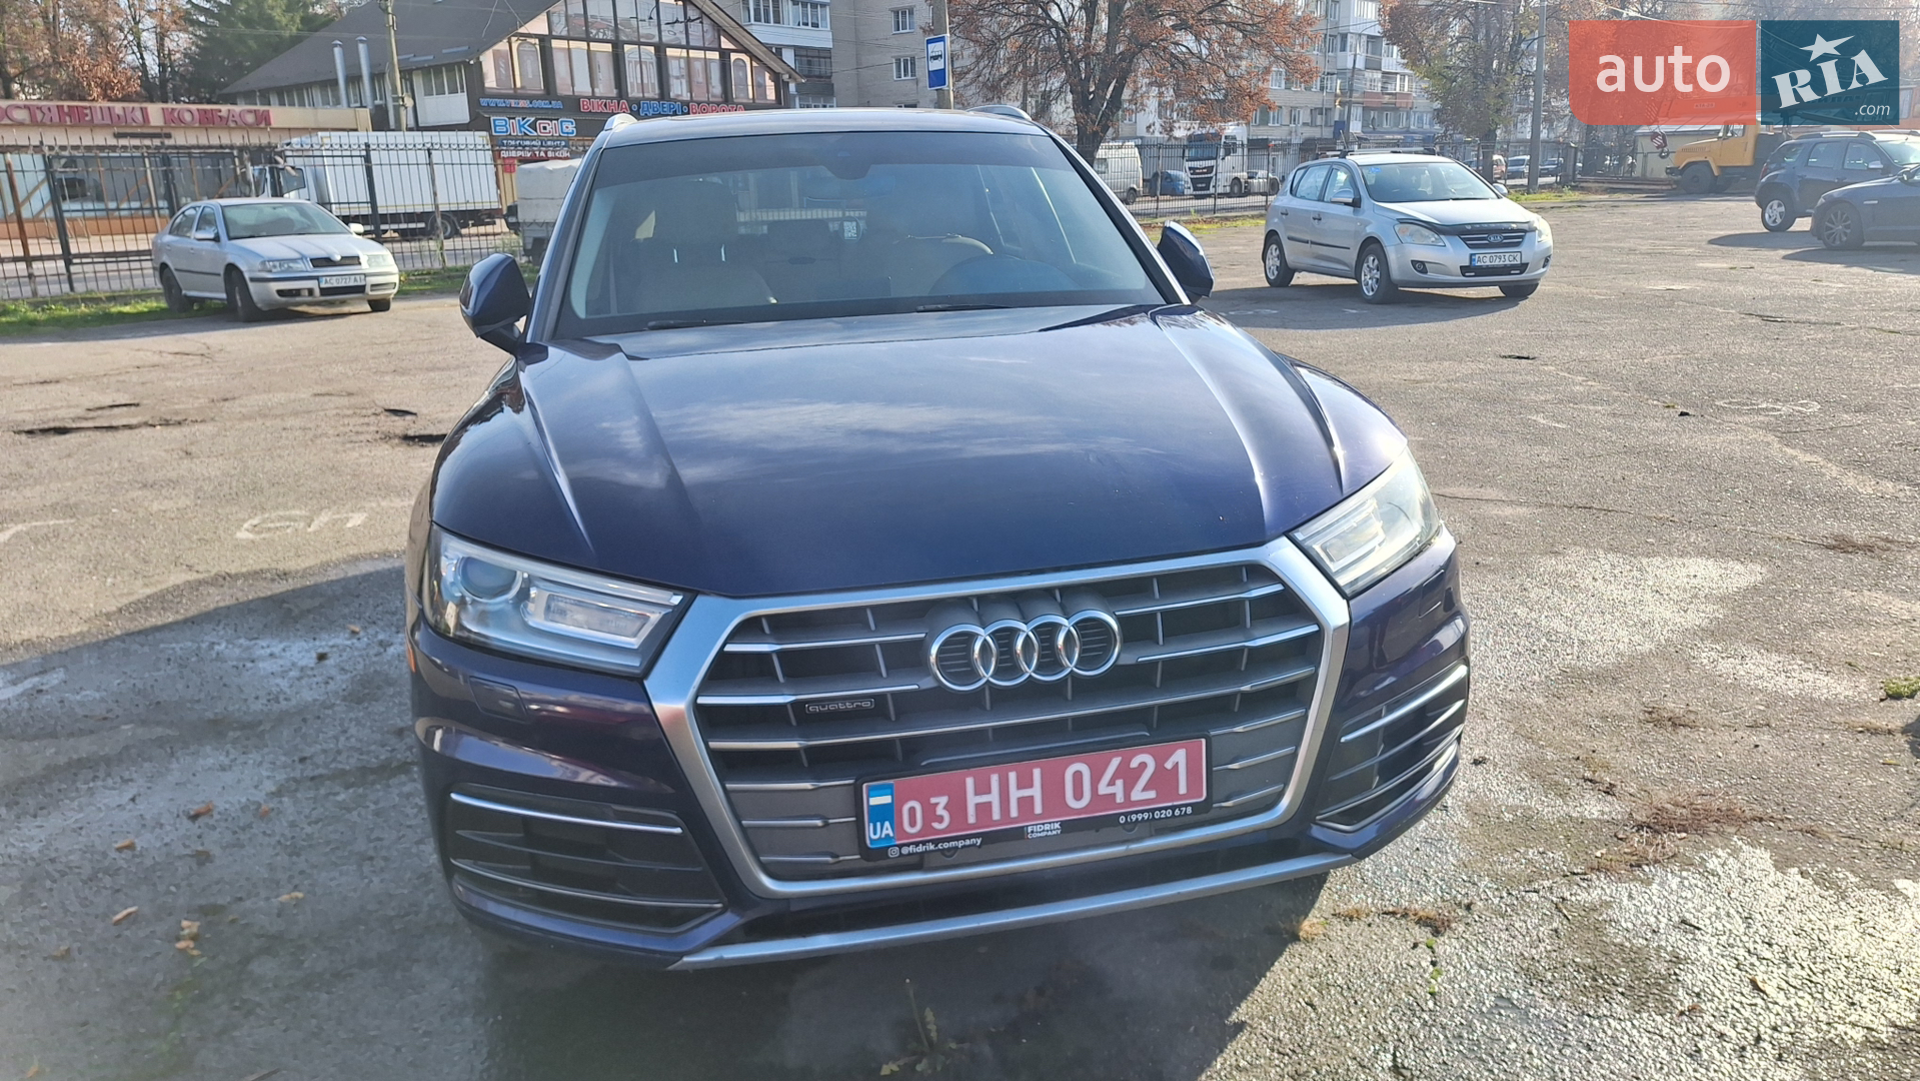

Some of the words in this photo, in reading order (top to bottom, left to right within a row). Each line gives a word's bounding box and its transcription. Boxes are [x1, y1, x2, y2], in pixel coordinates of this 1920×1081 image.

[0, 103, 150, 125] СТЯНЕЦЬКІ
[163, 107, 272, 126] КОВБАСИ
[580, 99, 629, 113] ВІКНА
[639, 101, 682, 116] ДВЕРІ
[1489, 254, 1507, 263] 0793
[1508, 254, 1518, 262] CK
[808, 702, 871, 712] quattro
[902, 795, 951, 835] 03
[966, 767, 1043, 825] HH
[1064, 748, 1188, 810] 0421
[1127, 811, 1152, 822] (999)
[1153, 809, 1172, 820] 020
[1174, 806, 1193, 817] 678
[869, 821, 894, 840] UA
[1027, 822, 1062, 833] FIDRIK
[1027, 829, 1062, 839] COMPANY
[901, 837, 982, 855] @fidrik.company
